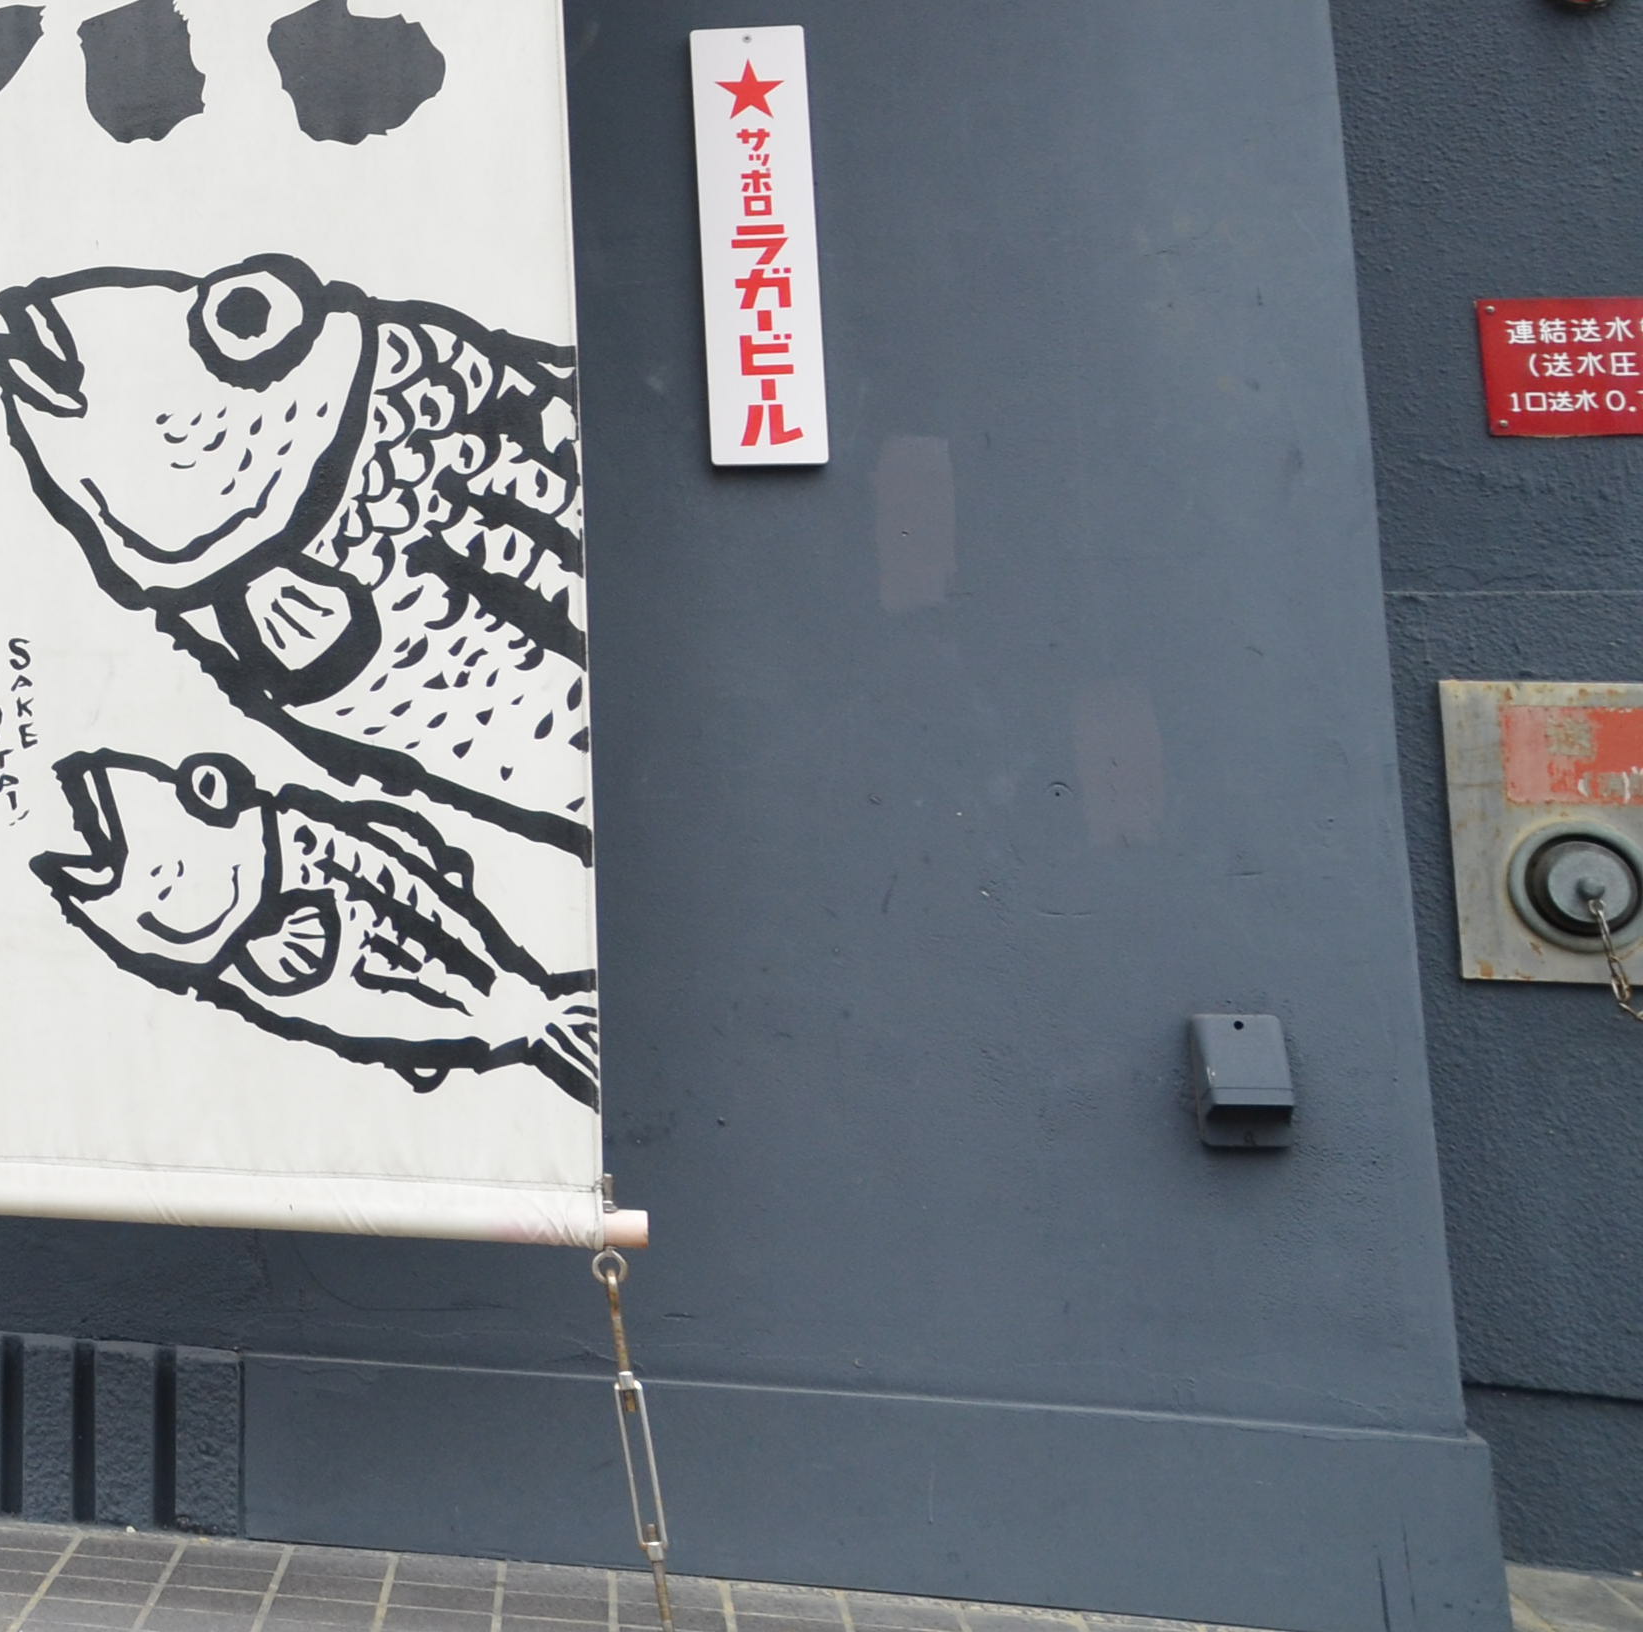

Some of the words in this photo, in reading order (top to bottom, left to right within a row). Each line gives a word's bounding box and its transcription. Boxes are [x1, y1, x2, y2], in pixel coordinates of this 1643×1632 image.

[731, 128, 804, 447] サッポロラガービール
[1504, 316, 1643, 345] 連結送水
[7, 637, 39, 749] SAKE
